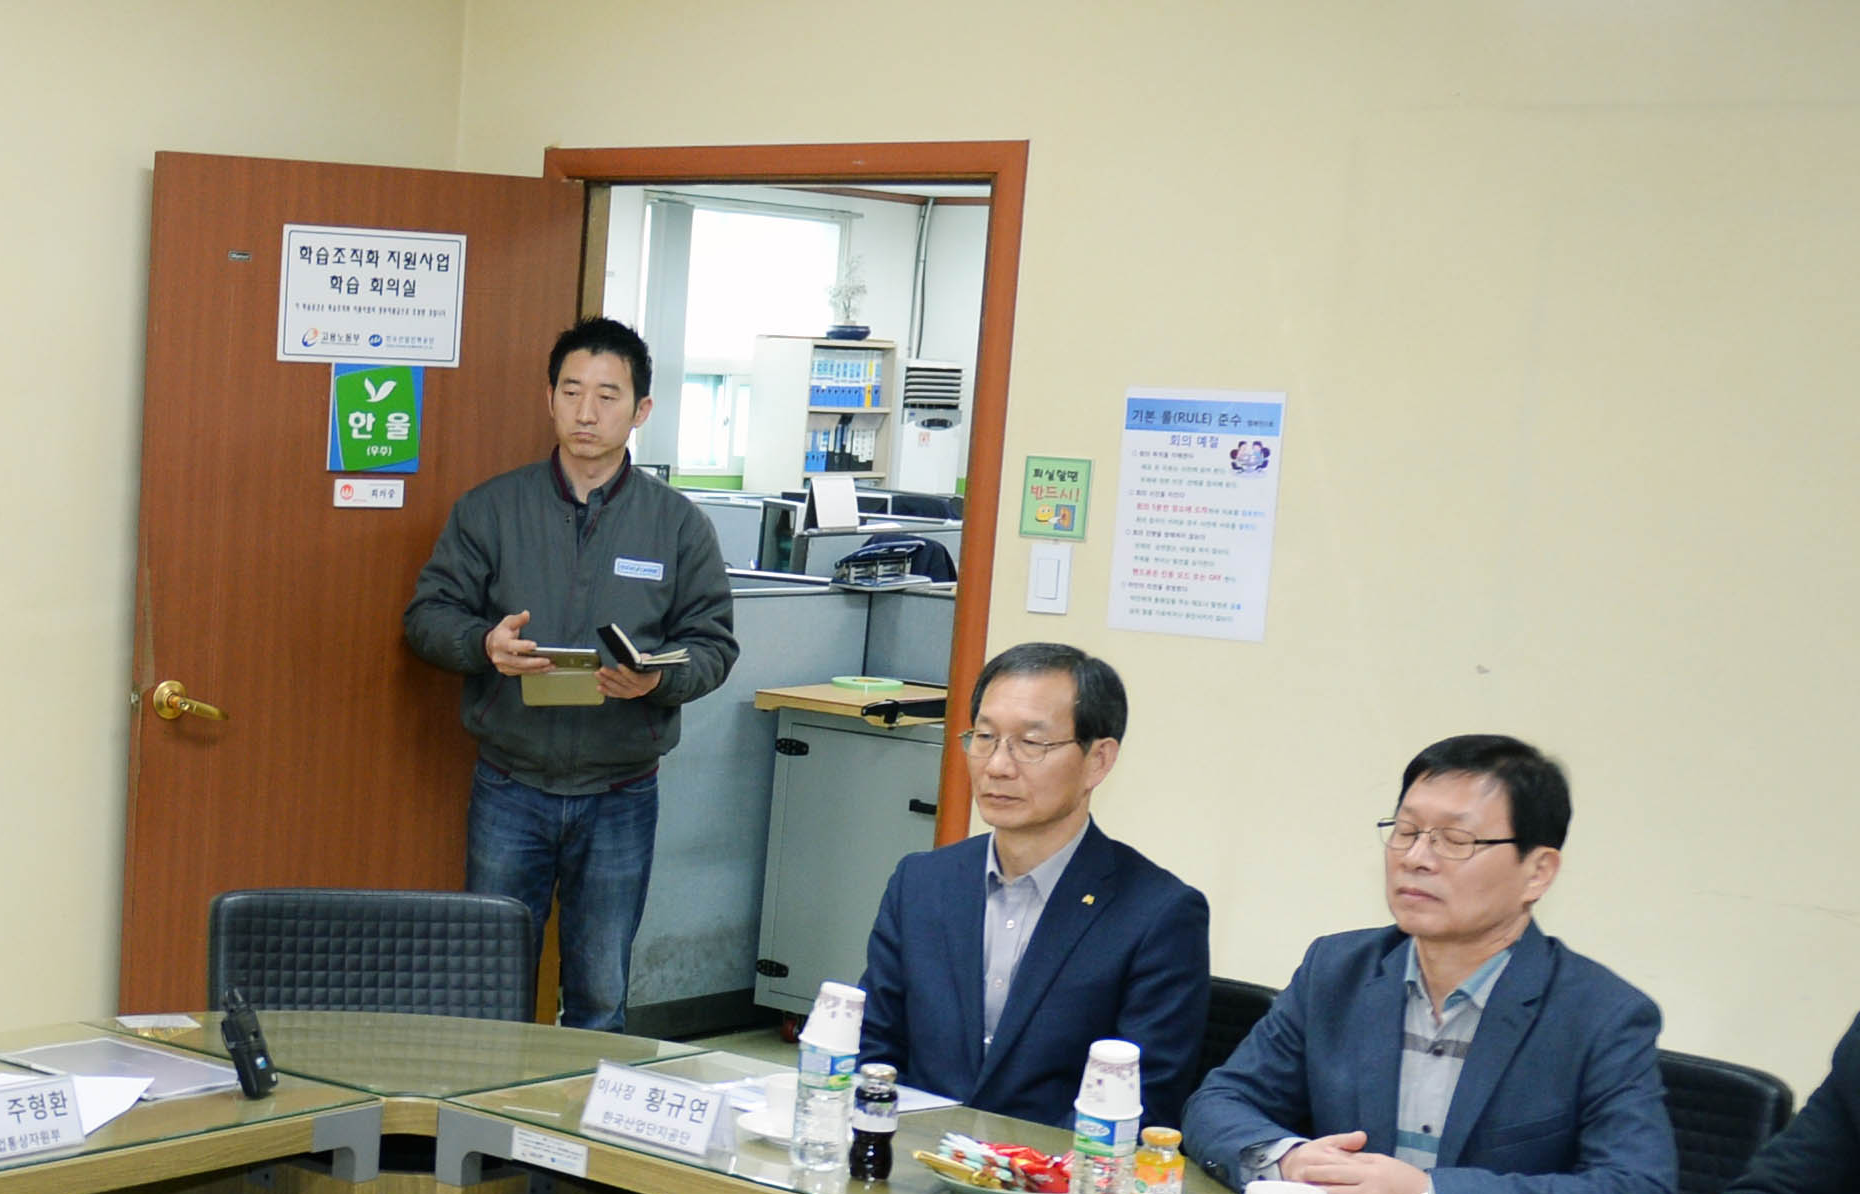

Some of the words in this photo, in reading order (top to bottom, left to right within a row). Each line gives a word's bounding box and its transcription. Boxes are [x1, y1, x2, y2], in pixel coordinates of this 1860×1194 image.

[300, 246, 379, 268] 학습조직화
[388, 251, 449, 272] 지원사업
[331, 275, 359, 294] 학습
[370, 278, 415, 297] 회의실
[1132, 410, 1156, 424] 기본
[1219, 414, 1242, 427] 준수
[1170, 435, 1192, 447] 회의
[1197, 436, 1219, 448] 예절
[7, 1089, 69, 1124] 주형환
[597, 1079, 636, 1100] 이사장
[645, 1088, 709, 1124] 황규연
[603, 1112, 691, 1145] 한국산업단지공단
